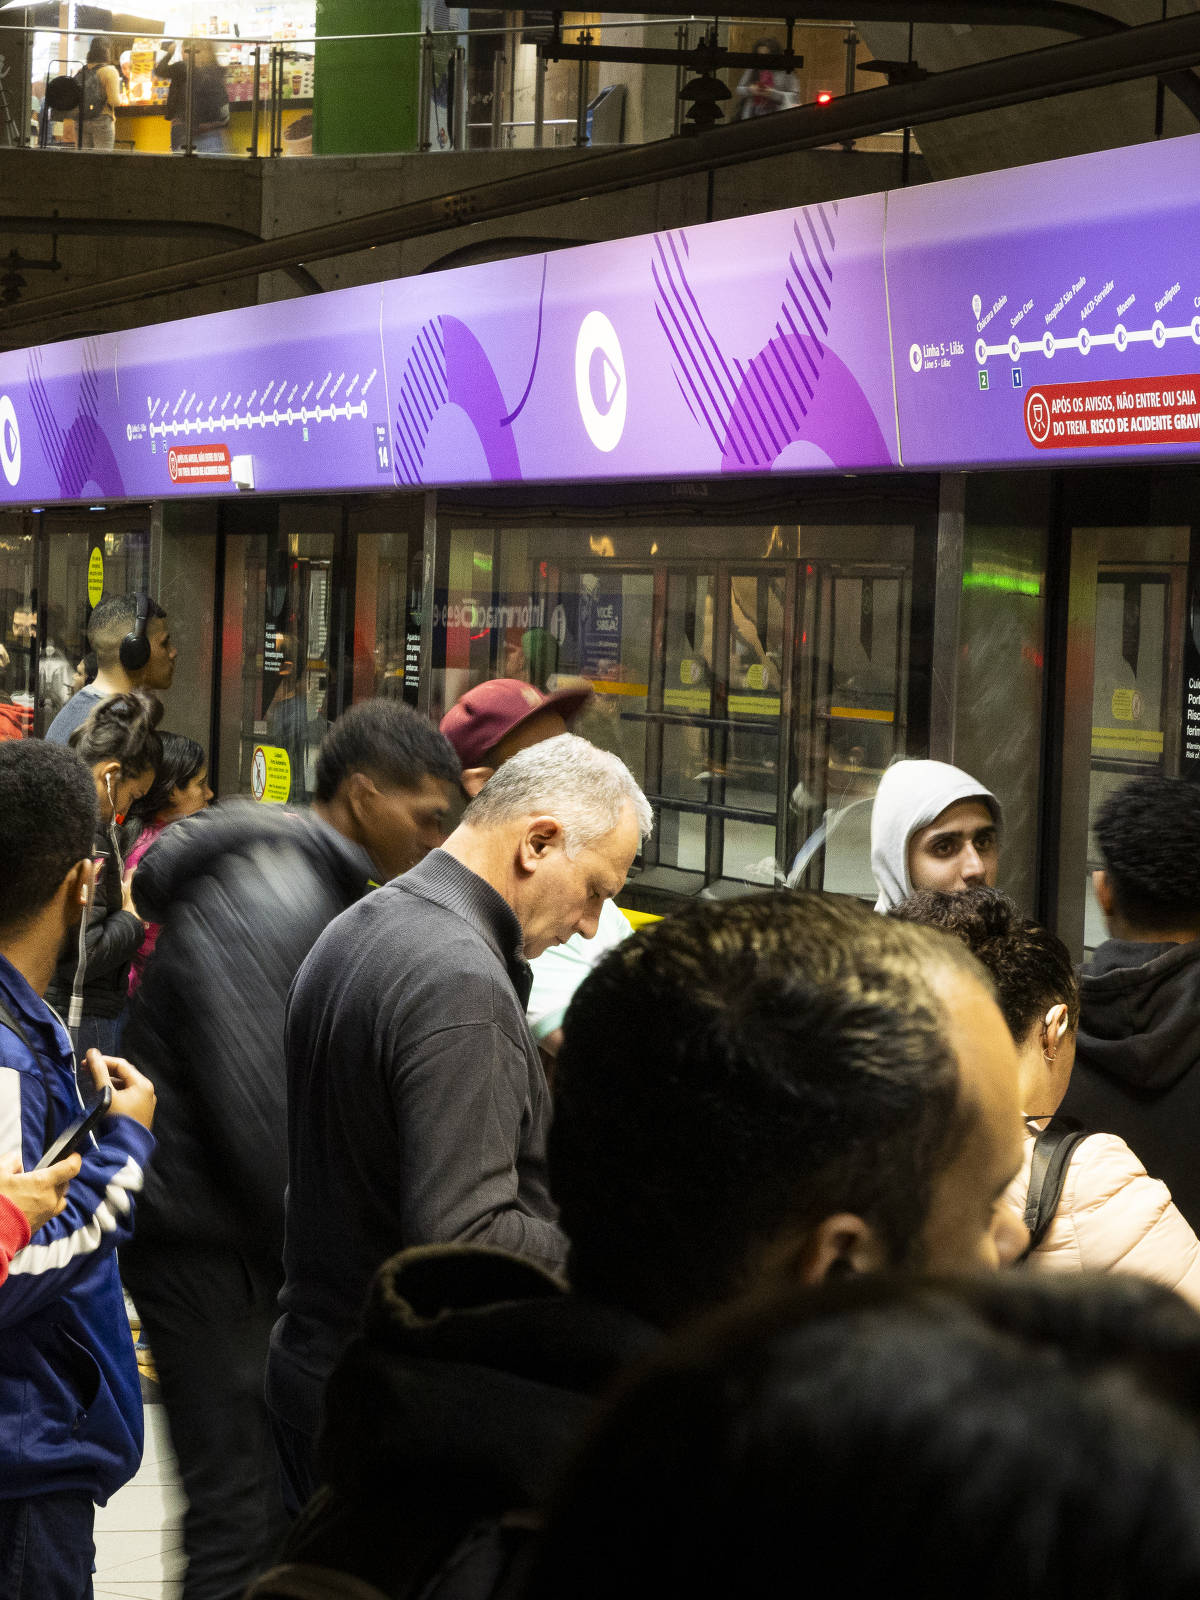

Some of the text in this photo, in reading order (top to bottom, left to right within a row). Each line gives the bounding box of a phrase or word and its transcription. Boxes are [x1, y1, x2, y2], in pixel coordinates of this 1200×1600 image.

[1045, 298, 1064, 325] Hospital
[1116, 294, 1135, 317] Moema
[1010, 311, 1024, 328] Santa
[923, 344, 939, 358] Linha
[940, 343, 945, 356] 5
[950, 341, 964, 355] Lilás
[982, 375, 986, 385] 2
[1015, 373, 1019, 384] 1
[1051, 390, 1196, 414] APÓS OS AVISOS, NÃO ENTRE OU SAIA
[1053, 422, 1064, 436] DO
[1066, 420, 1089, 435] TREM.
[1091, 418, 1116, 434] RISCO
[1117, 417, 1128, 432] DE
[1131, 415, 1173, 432] ACIDENTE
